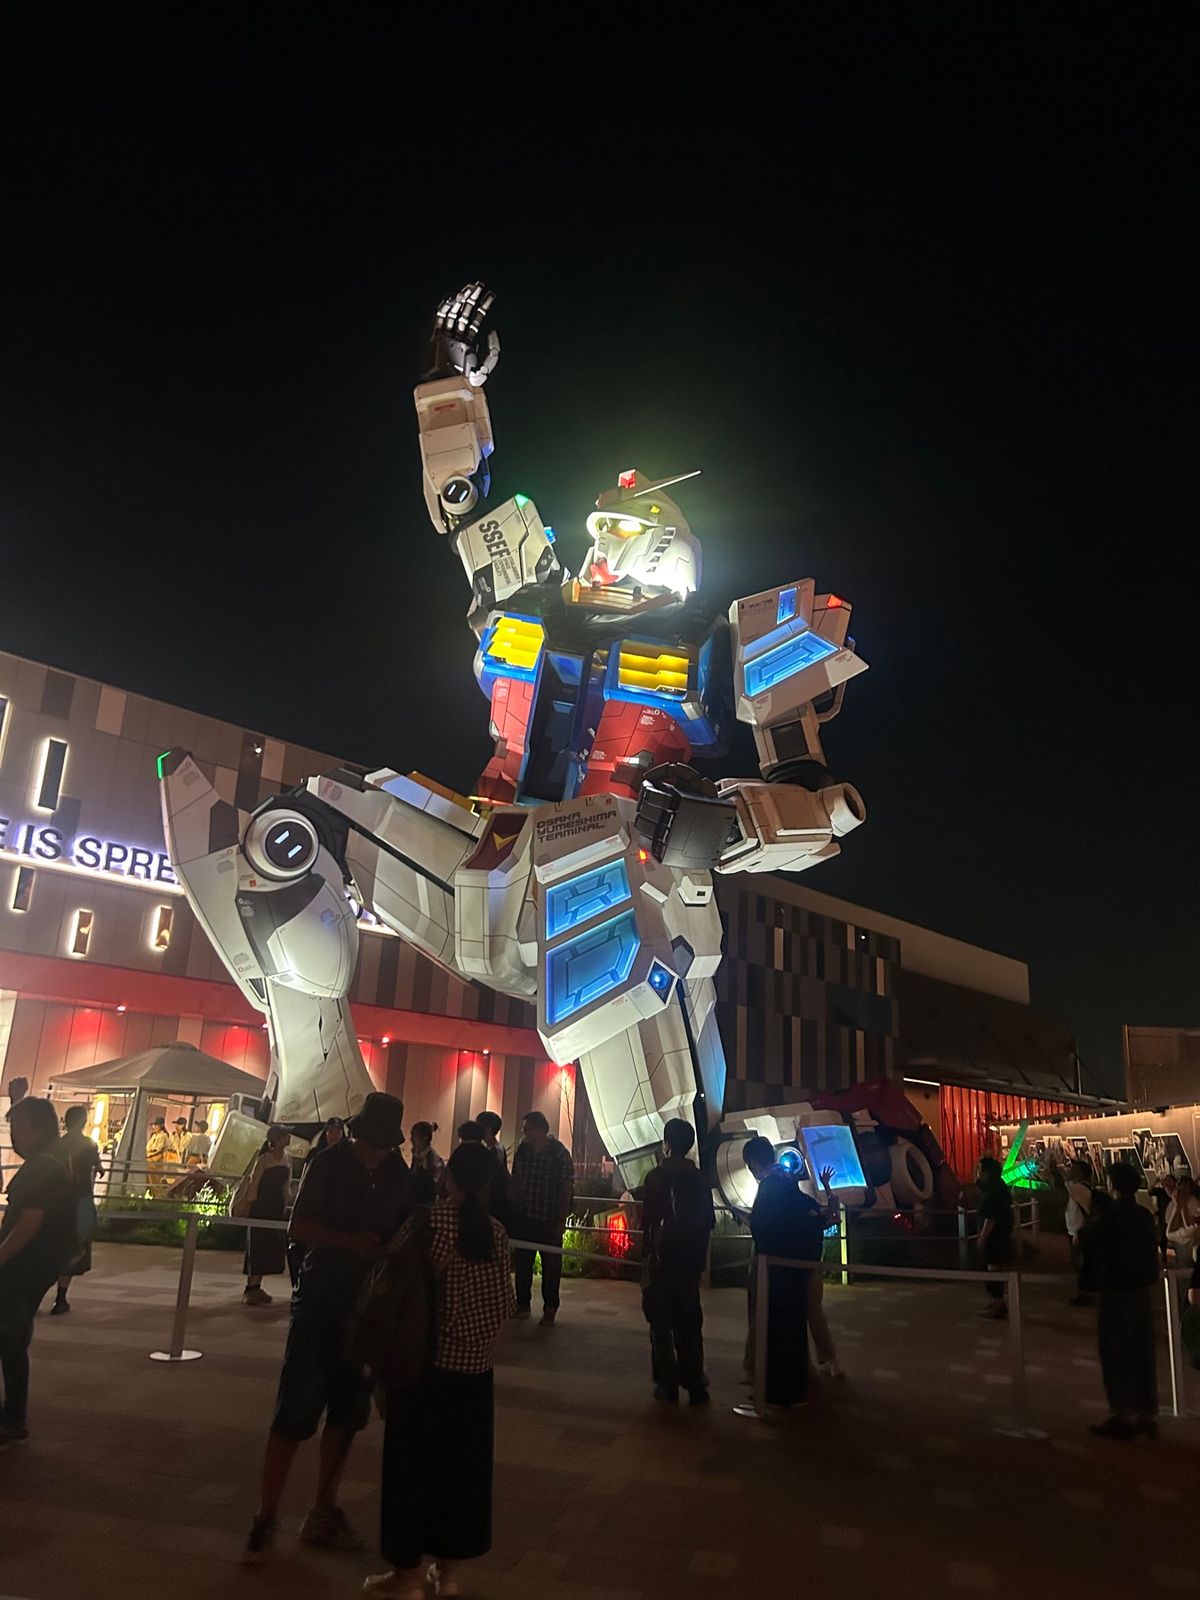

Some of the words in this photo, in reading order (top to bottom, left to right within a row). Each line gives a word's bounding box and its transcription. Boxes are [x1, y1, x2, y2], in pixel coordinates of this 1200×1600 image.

[478, 519, 512, 558] SSEF
[536, 811, 581, 829] OSAKA
[537, 810, 617, 835] YUMESHIMA
[537, 822, 606, 843] TERMINAL
[21, 824, 63, 860] IS
[75, 837, 181, 885] SPRE
